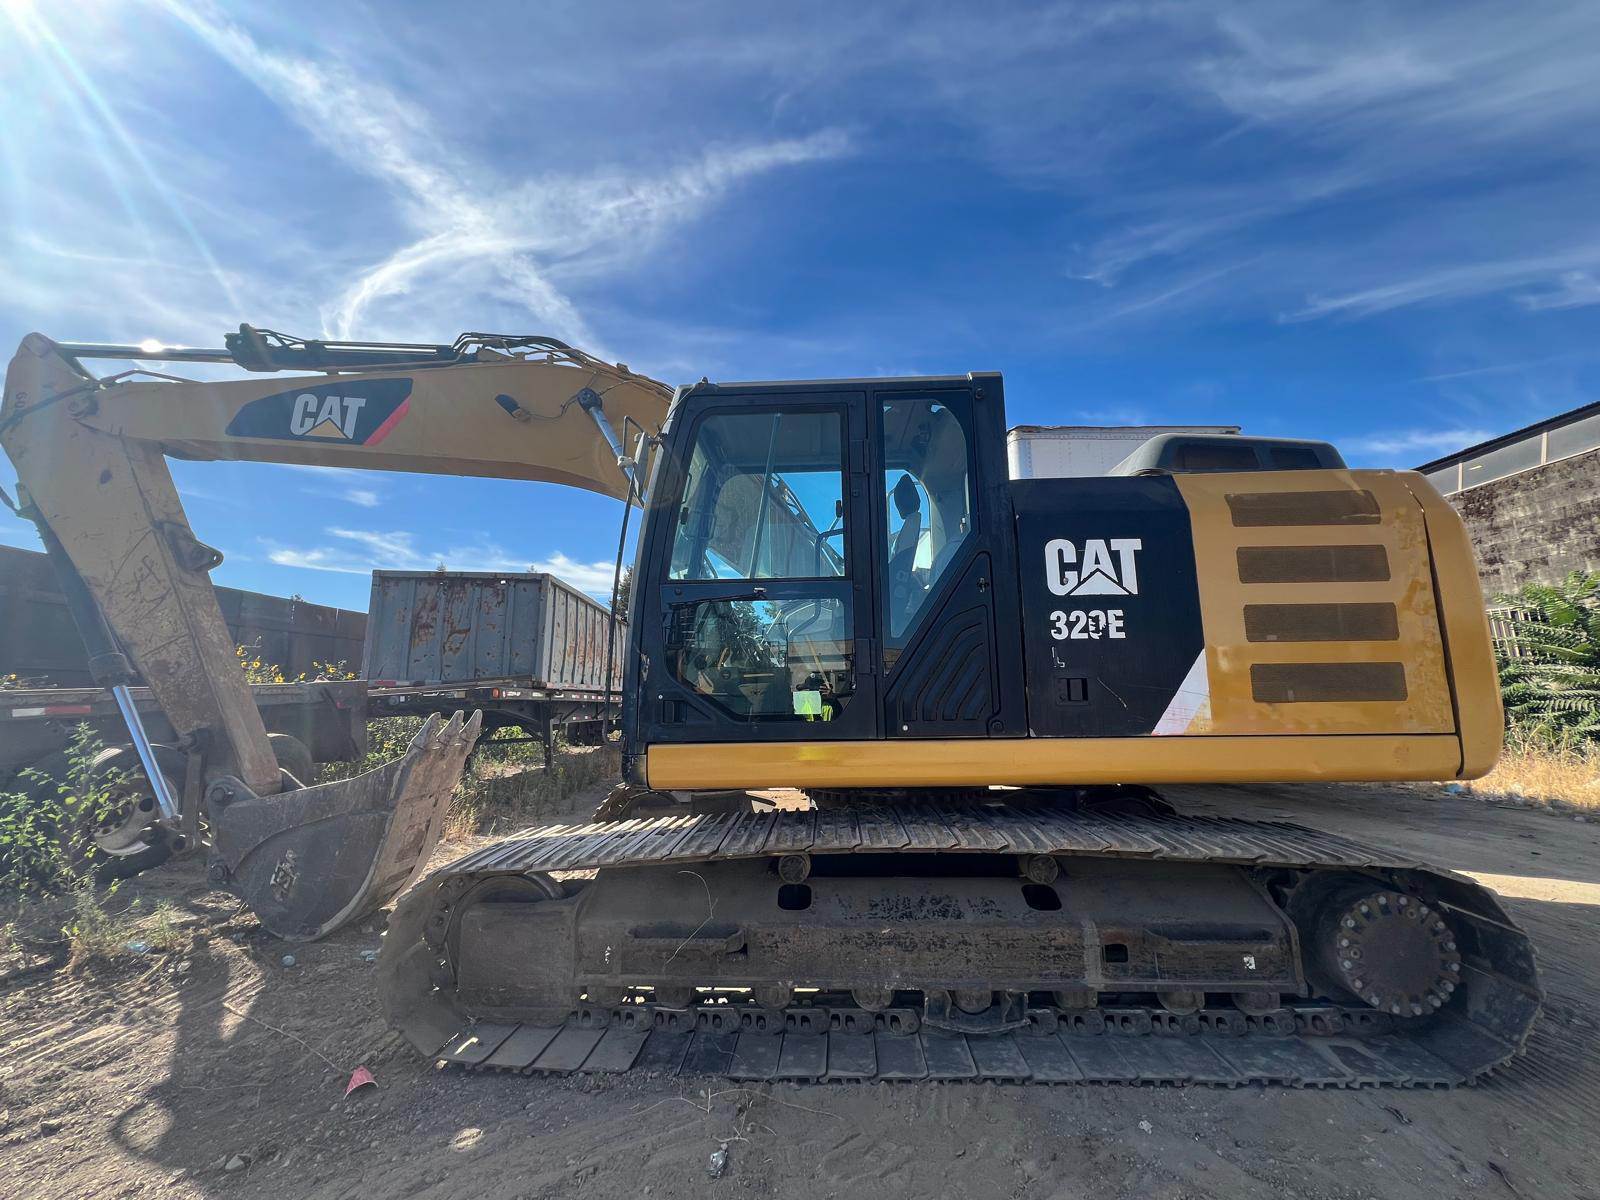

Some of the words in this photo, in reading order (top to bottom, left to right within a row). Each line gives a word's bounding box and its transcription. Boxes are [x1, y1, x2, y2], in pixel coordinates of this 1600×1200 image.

[290, 393, 367, 440] CAT
[1044, 538, 1142, 596] CAT
[1049, 609, 1126, 640] 320E
